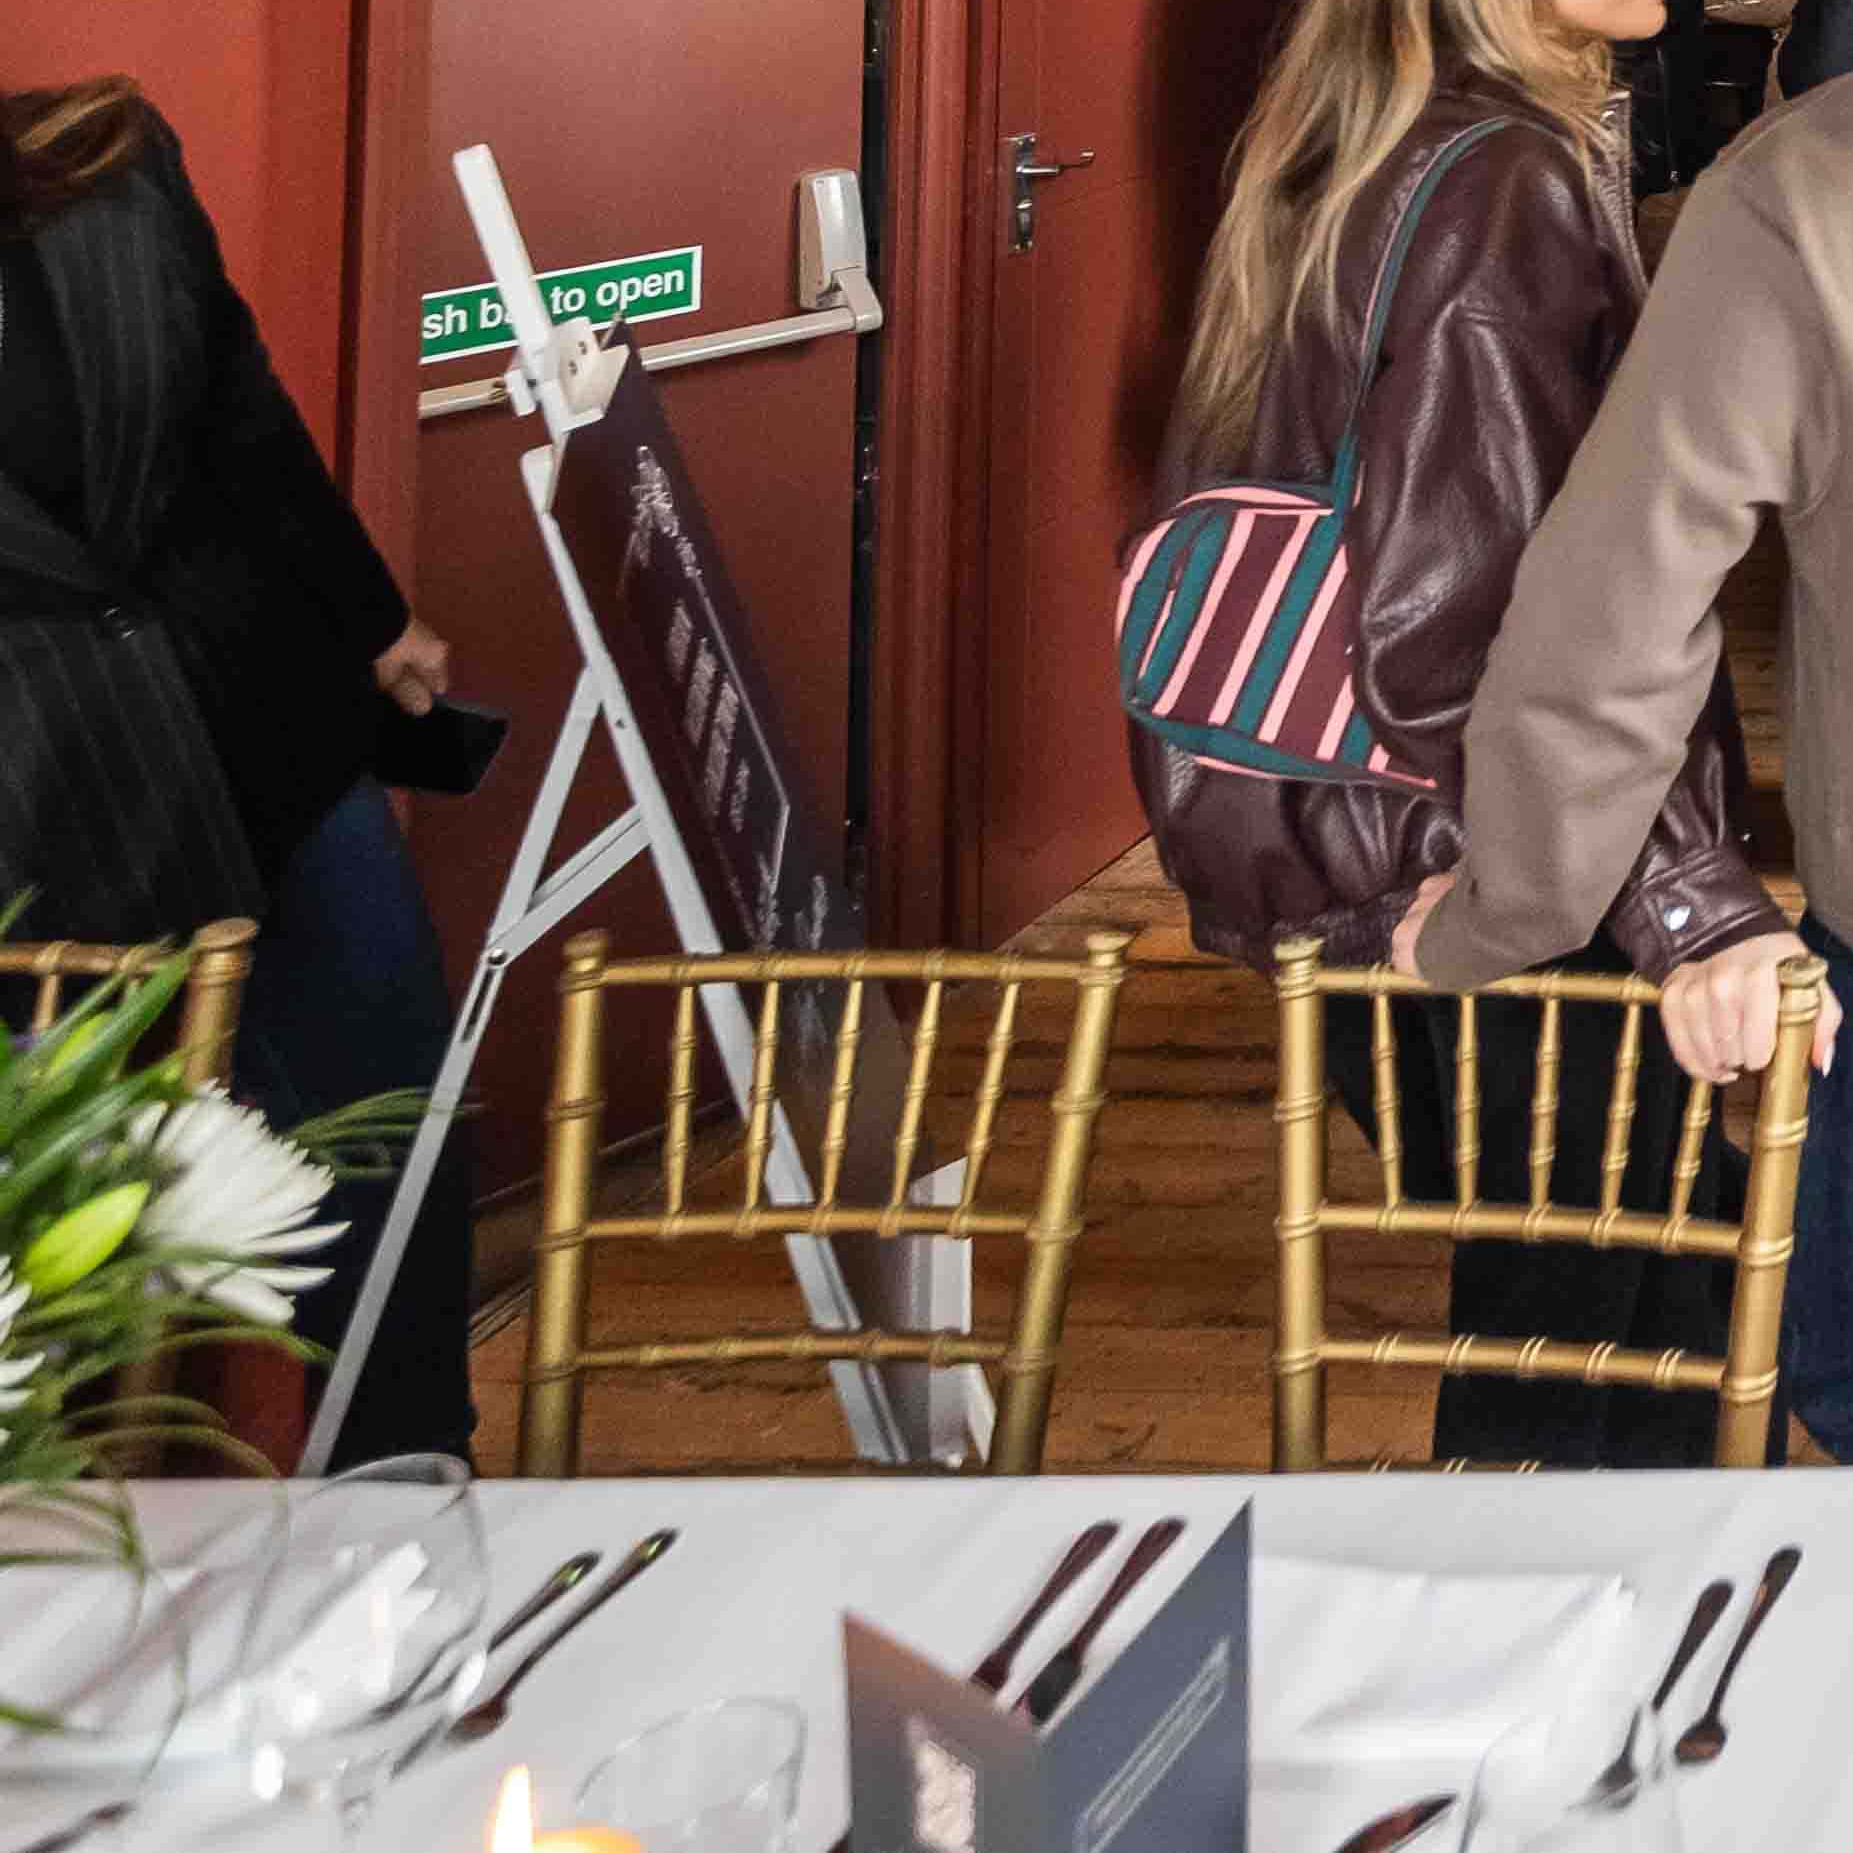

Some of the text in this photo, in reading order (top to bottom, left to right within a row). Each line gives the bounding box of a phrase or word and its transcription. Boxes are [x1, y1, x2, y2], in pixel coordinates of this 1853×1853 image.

[422, 303, 468, 340] sh
[549, 284, 586, 315] to
[595, 268, 684, 310] open
